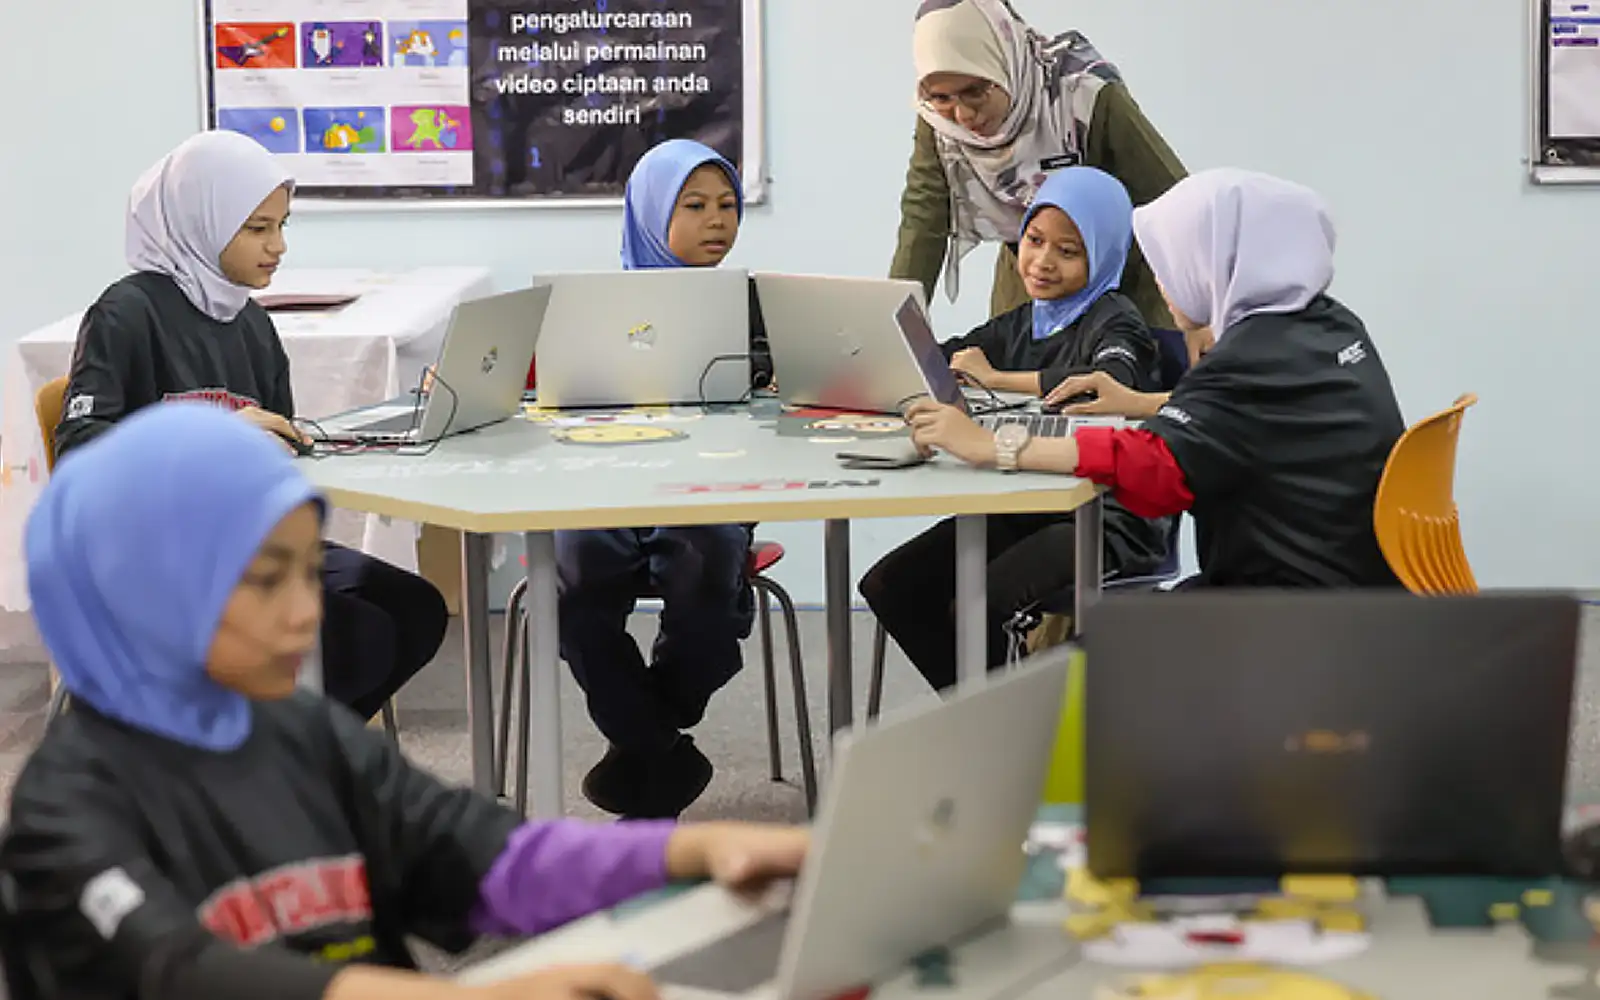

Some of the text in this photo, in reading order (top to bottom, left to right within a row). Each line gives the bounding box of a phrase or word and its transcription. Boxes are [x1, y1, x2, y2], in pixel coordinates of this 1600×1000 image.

[511, 9, 693, 34] pengaturcaraan
[498, 40, 706, 65] melalui permainan
[495, 73, 709, 97] video ciptaan anda
[562, 104, 641, 125] sendiri
